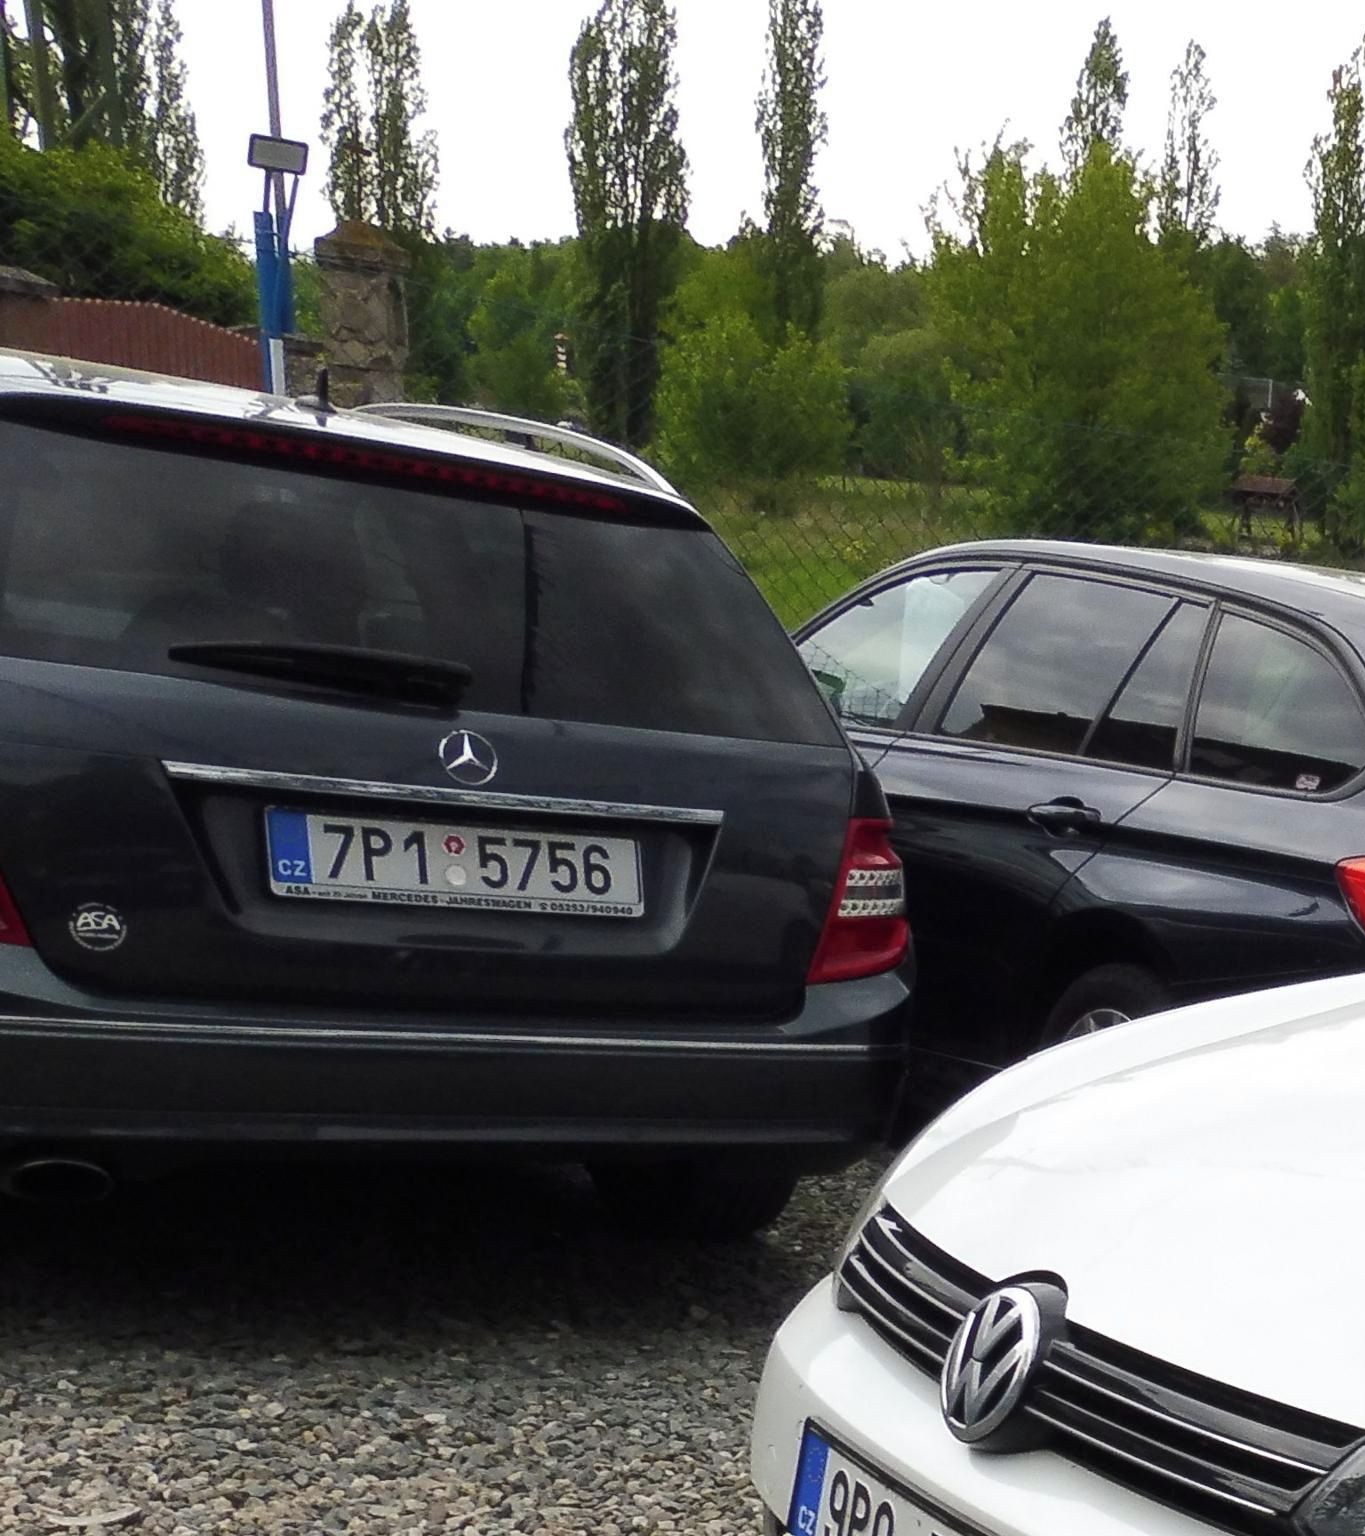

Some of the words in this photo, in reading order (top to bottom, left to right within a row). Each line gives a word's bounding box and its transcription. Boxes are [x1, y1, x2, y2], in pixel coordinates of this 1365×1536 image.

[278, 859, 307, 876] CZ
[323, 823, 429, 885] 7P1
[477, 835, 612, 895] 5756
[285, 886, 311, 896] ASA
[798, 1505, 815, 1536] CZ
